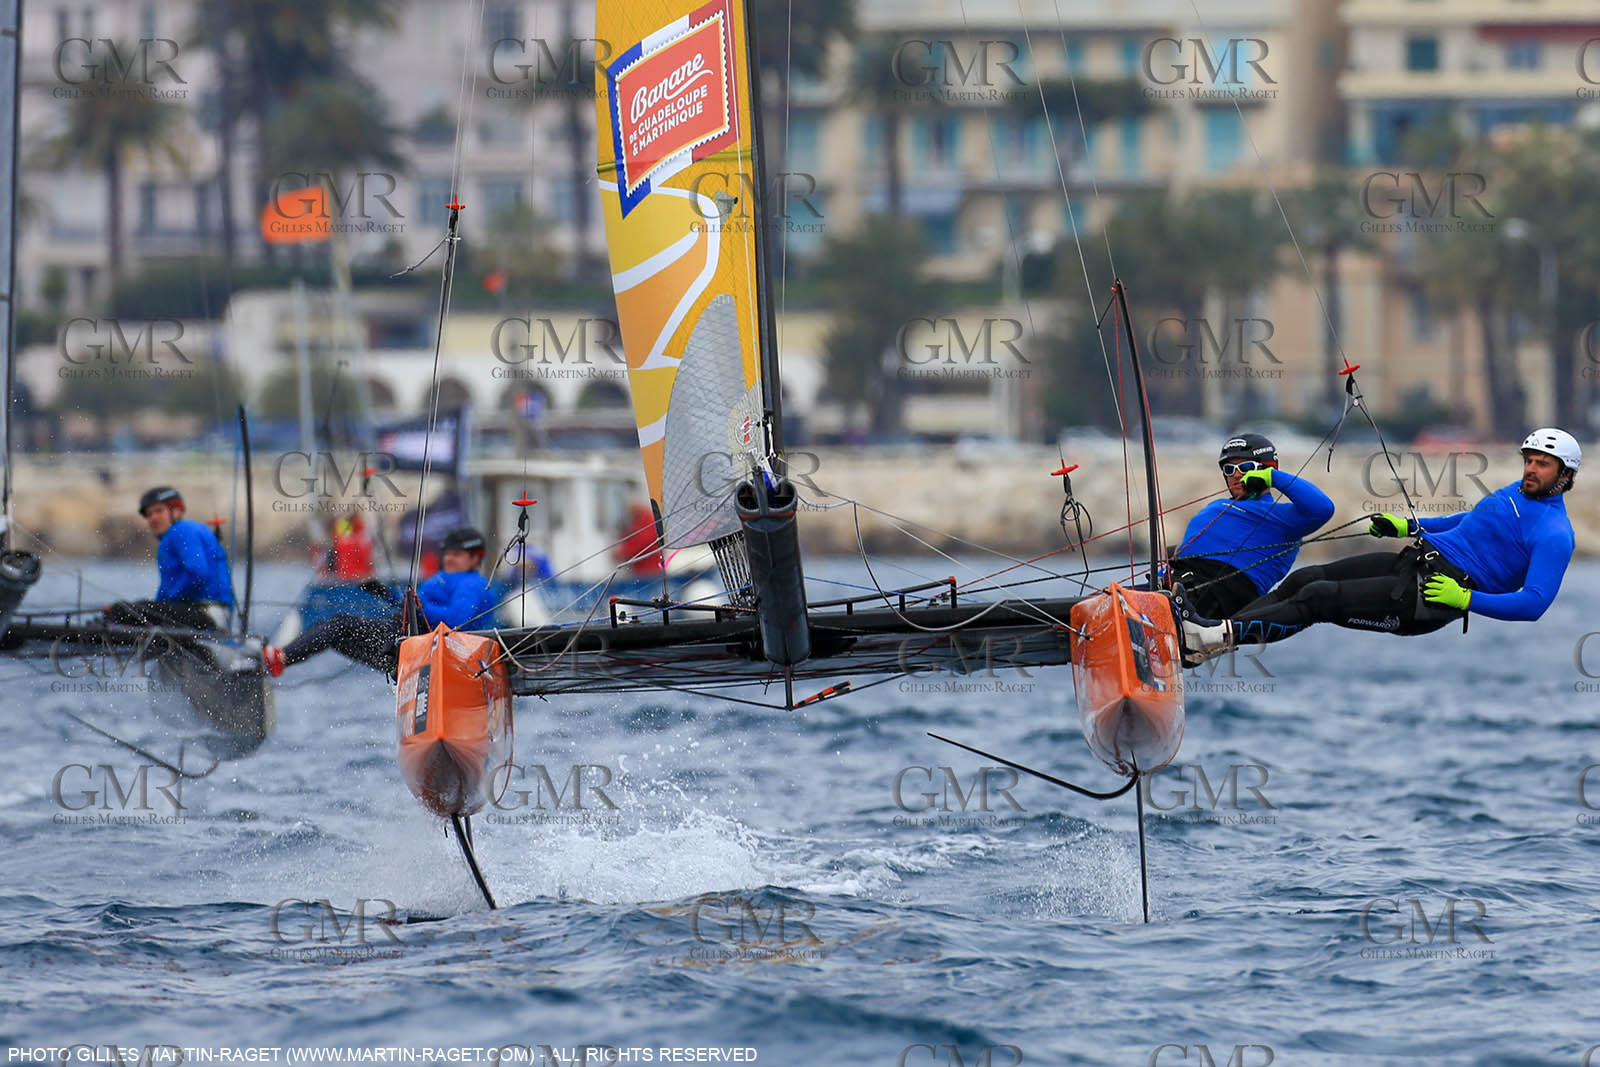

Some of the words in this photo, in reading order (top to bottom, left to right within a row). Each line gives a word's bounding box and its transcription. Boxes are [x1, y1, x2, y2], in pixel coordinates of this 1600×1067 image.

[629, 130, 638, 144] DE
[638, 85, 708, 135] GUADELOUPE
[630, 53, 713, 124] Banane
[632, 141, 639, 156] &
[640, 101, 703, 151] MARTINIQUE
